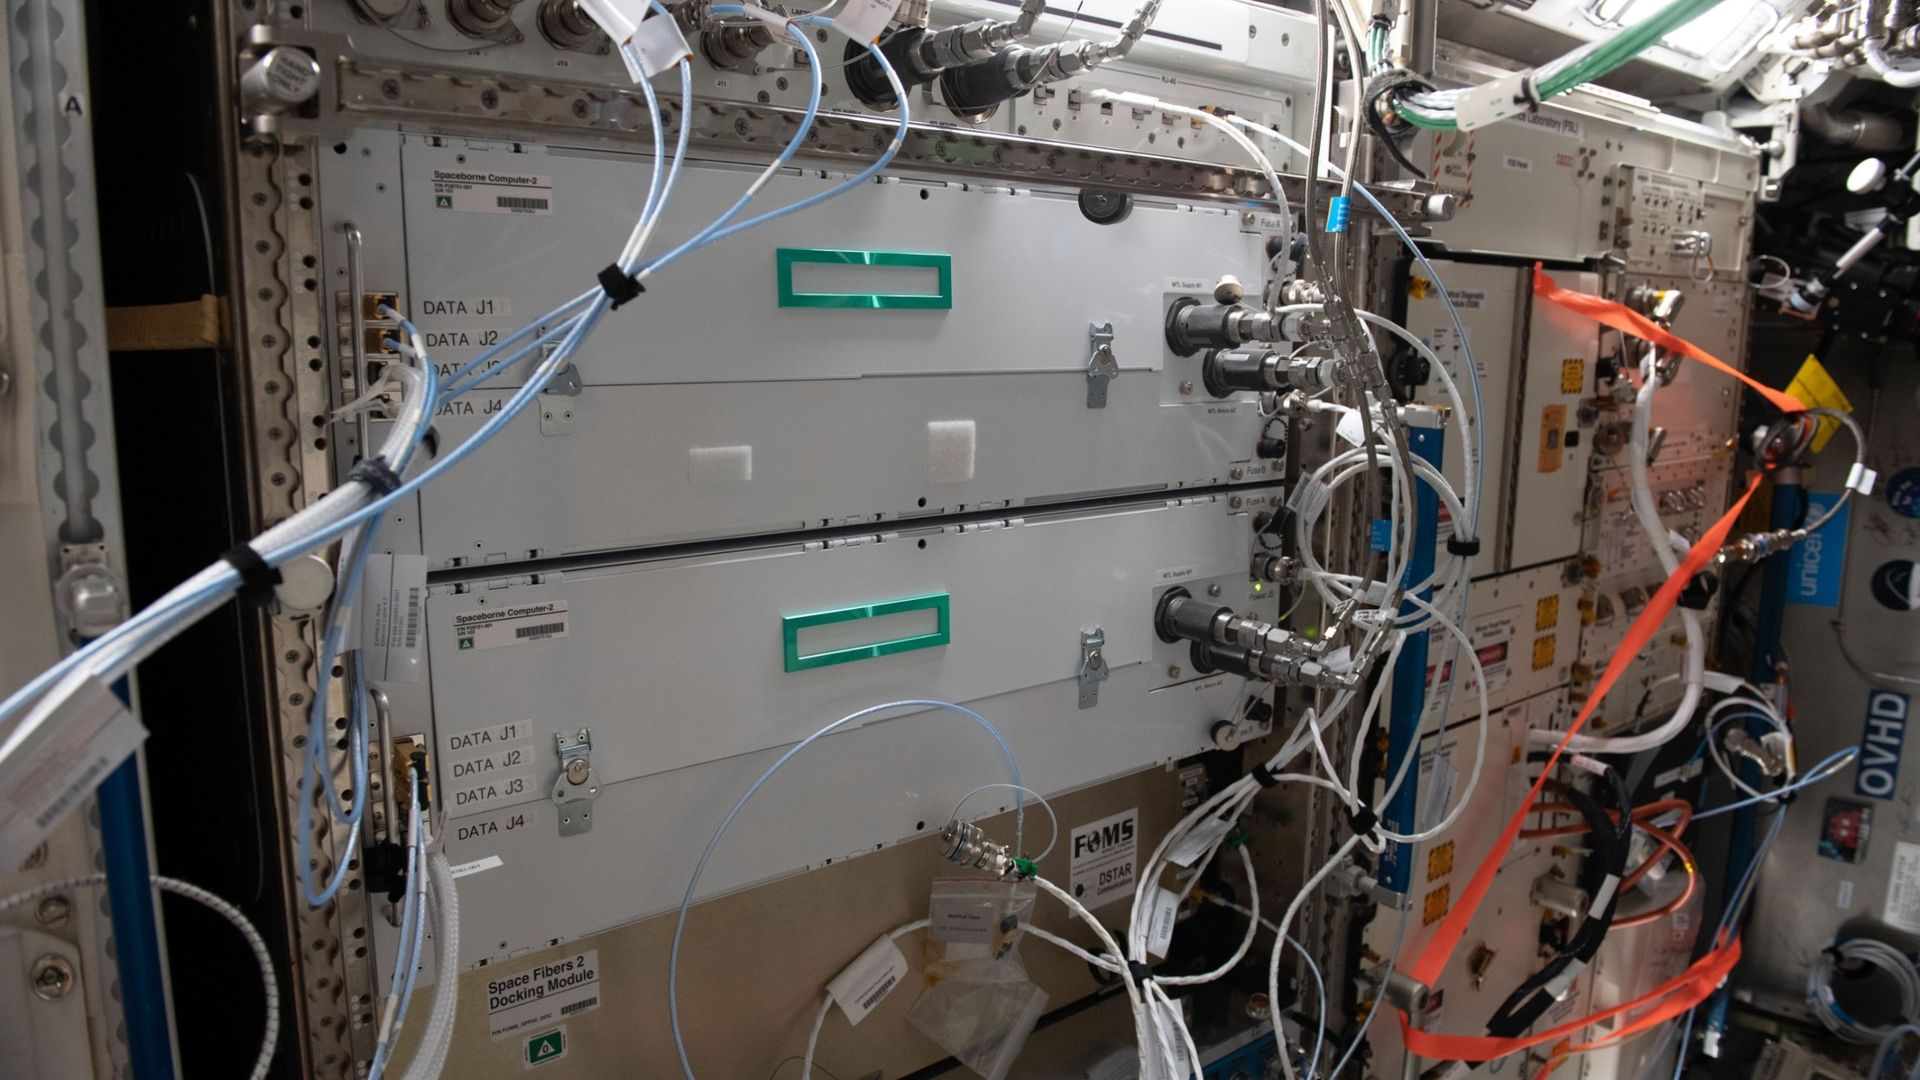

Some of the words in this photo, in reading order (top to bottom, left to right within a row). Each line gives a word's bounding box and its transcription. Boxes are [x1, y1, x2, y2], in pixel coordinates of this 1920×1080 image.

[65, 96, 82, 116] A
[1528, 114, 1561, 131] Laboratory
[433, 170, 486, 183] Spaceborne
[488, 174, 538, 185] Computer-2
[423, 300, 467, 315] DATA
[476, 299, 493, 315] J1
[426, 332, 470, 347] DATA
[480, 330, 498, 346] J2
[483, 400, 502, 415] J4
[1247, 466, 1261, 475] Fuse
[456, 610, 505, 624] Spaceborne
[507, 604, 554, 617] Computer-2
[450, 731, 492, 750] DATA
[500, 724, 516, 741] J1
[1859, 692, 1907, 797] OVHD
[453, 758, 494, 777] DATA
[502, 750, 521, 767] J2
[456, 785, 497, 805] DATA
[505, 778, 523, 795] J3
[458, 821, 498, 841] DATA
[506, 814, 525, 831] J4
[1075, 818, 1134, 859] FOMS
[1099, 863, 1132, 886] DSTAR
[488, 974, 529, 995] Space
[533, 960, 574, 981] Fibers
[576, 955, 585, 968] 2
[490, 985, 544, 1010] Docking
[547, 969, 594, 992] Module
[542, 1044, 549, 1054] 0
